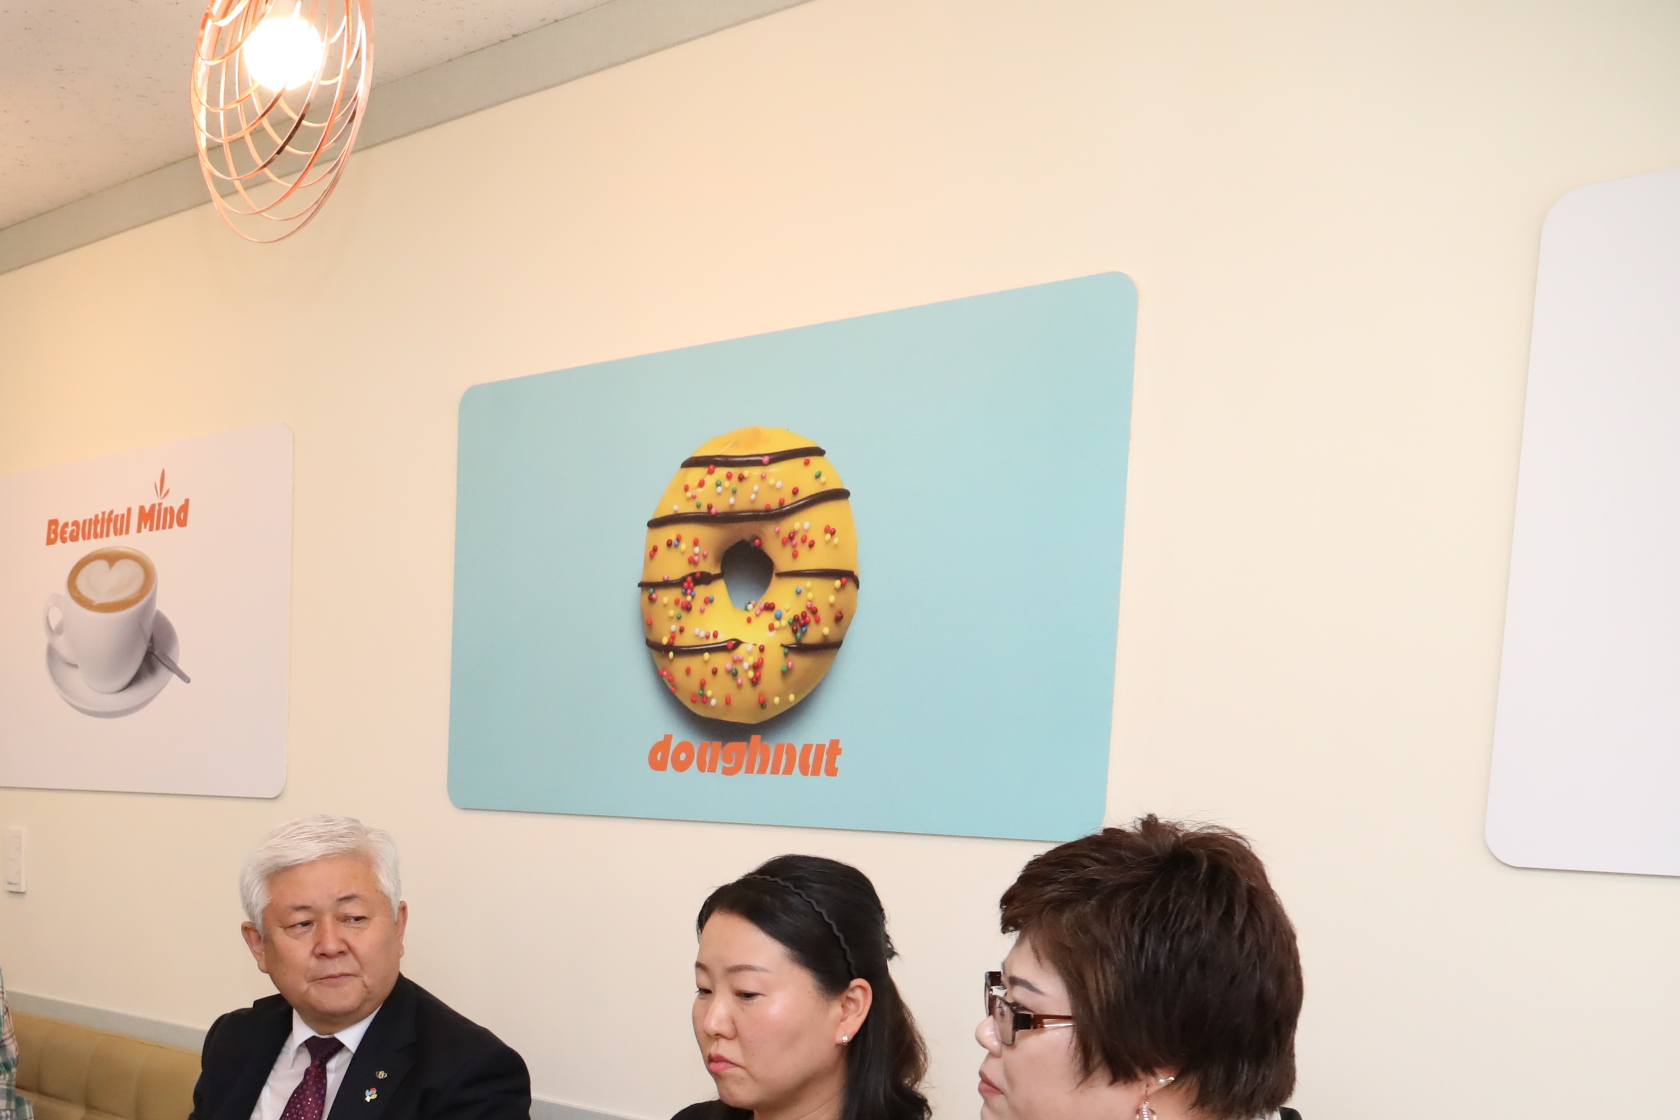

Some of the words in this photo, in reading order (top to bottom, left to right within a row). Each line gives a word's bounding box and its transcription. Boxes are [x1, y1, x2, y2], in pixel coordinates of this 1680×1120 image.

[45, 506, 132, 546] Beautiful
[136, 497, 190, 534] Mind
[647, 733, 843, 777] doughnut
